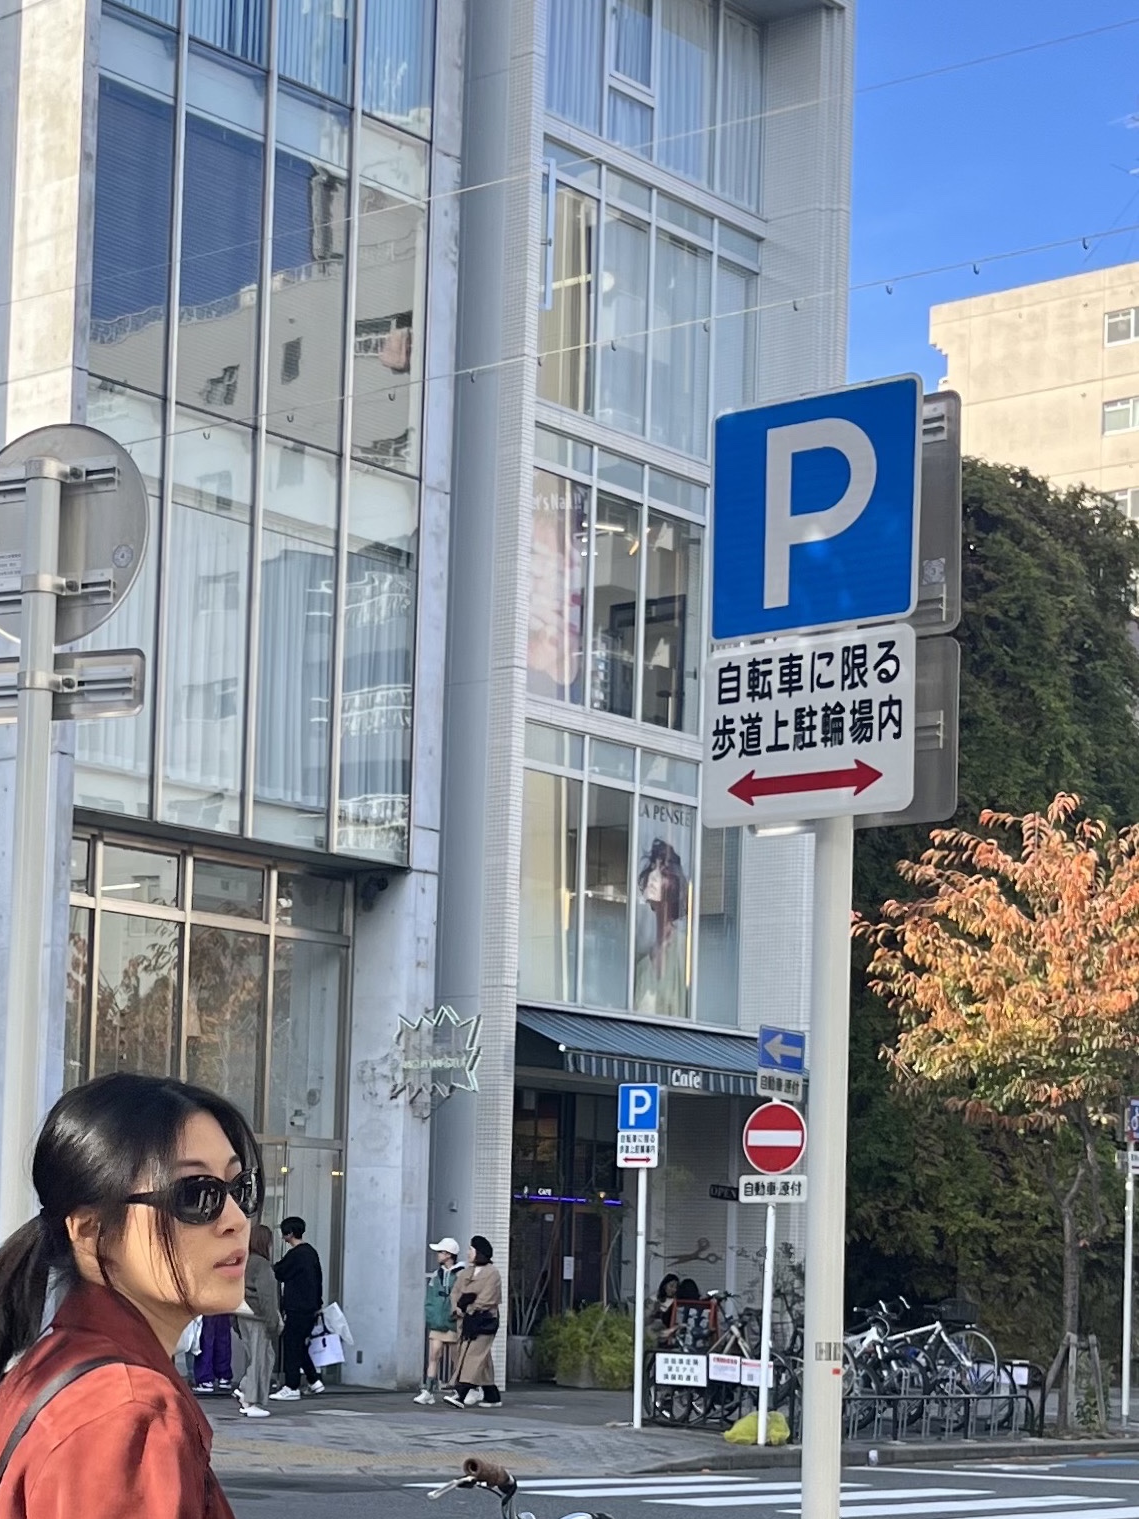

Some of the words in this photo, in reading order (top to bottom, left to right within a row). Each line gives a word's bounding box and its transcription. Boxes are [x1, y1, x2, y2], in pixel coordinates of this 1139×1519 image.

[763, 417, 877, 610] P
[716, 639, 901, 706] 自転車に限る
[710, 694, 903, 761] 歩道上駐輪場内
[629, 1089, 652, 1126] P
